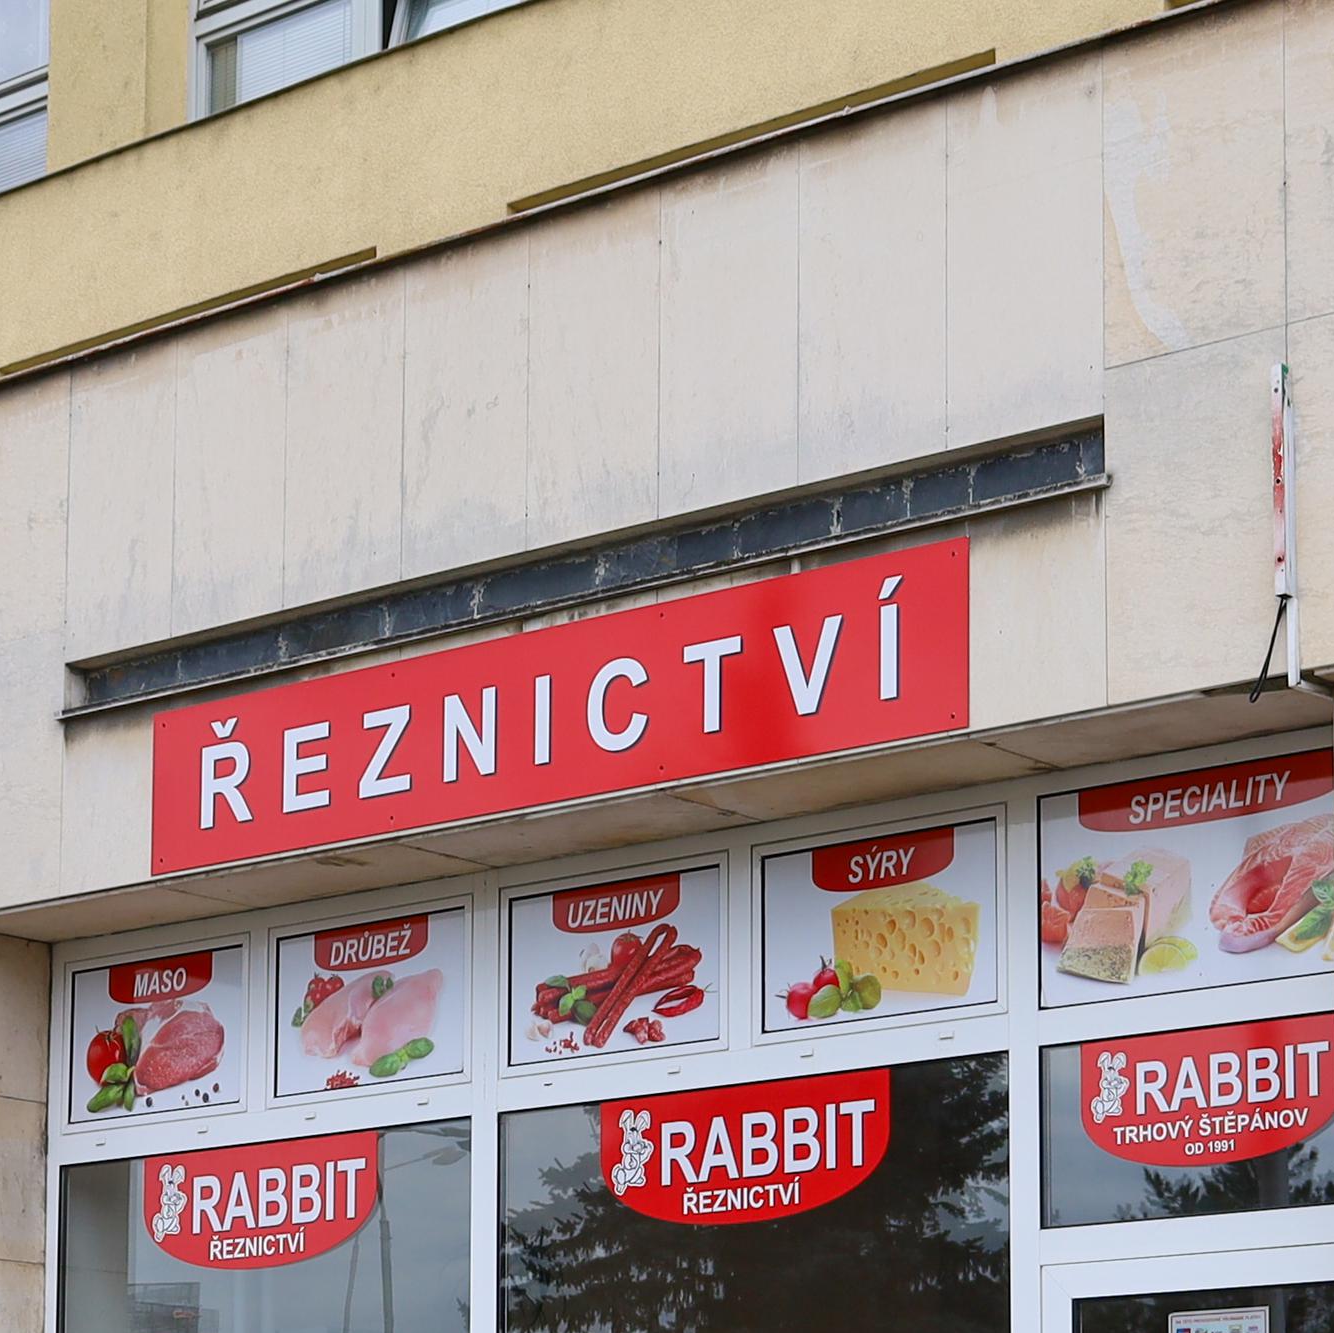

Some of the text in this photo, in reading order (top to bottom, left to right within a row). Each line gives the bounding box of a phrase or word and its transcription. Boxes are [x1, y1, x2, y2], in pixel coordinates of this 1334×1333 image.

[199, 574, 903, 830] ŘEZNICTVÍ
[1128, 771, 1291, 826] SPECIALITY
[848, 846, 916, 884] SÝRY
[567, 888, 665, 929] UZENINY
[329, 921, 414, 967] DRŮBEŽ
[133, 967, 187, 998] MASO
[1135, 1040, 1330, 1117] RABBIT
[660, 1099, 876, 1188] RABBIT
[1113, 1106, 1310, 1147] TRHOVÝ ŠTĚPÁNOV
[1184, 1139, 1236, 1156] OD 1991
[191, 1158, 367, 1234] RABBIT
[682, 1176, 800, 1217] ŘEZNICTVÍ
[208, 1226, 306, 1262] ŘEZNICTVÍ
